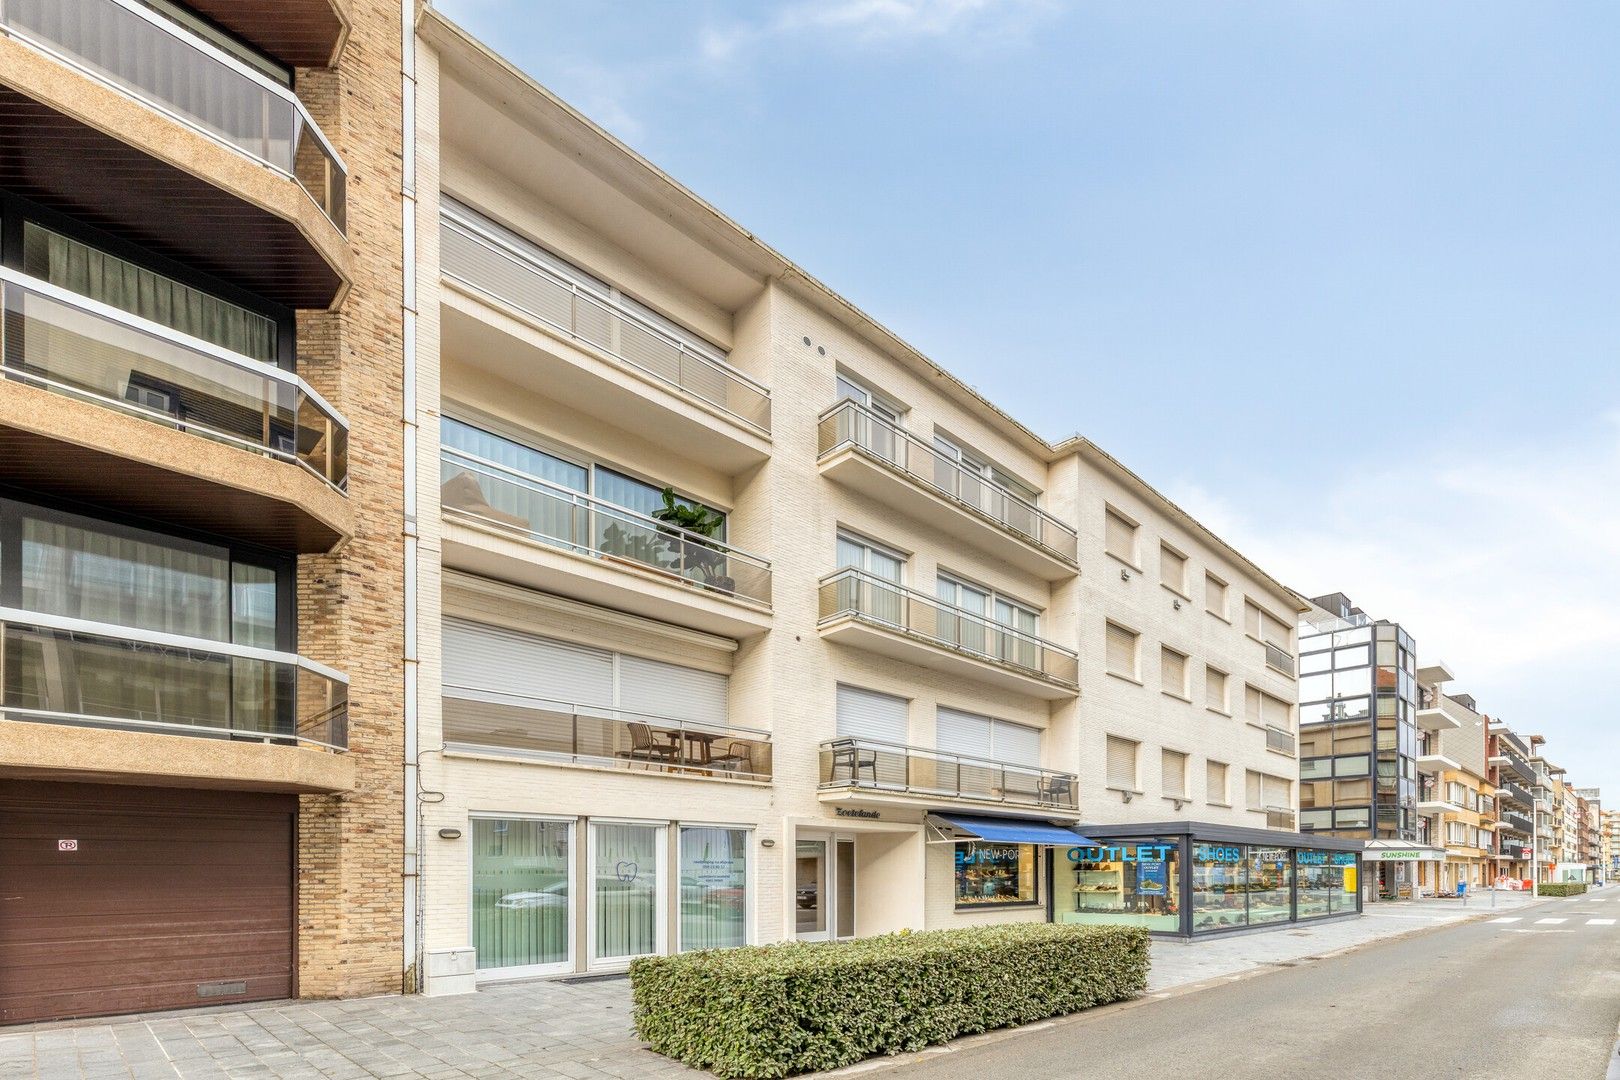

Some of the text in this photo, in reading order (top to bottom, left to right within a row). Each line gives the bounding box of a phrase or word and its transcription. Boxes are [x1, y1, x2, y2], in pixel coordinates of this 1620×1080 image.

[979, 848, 1021, 860] NEW-POR
[1067, 845, 1172, 862] OUTLET
[1199, 847, 1240, 862] SHOES
[1381, 851, 1420, 859] SUNSHINE
